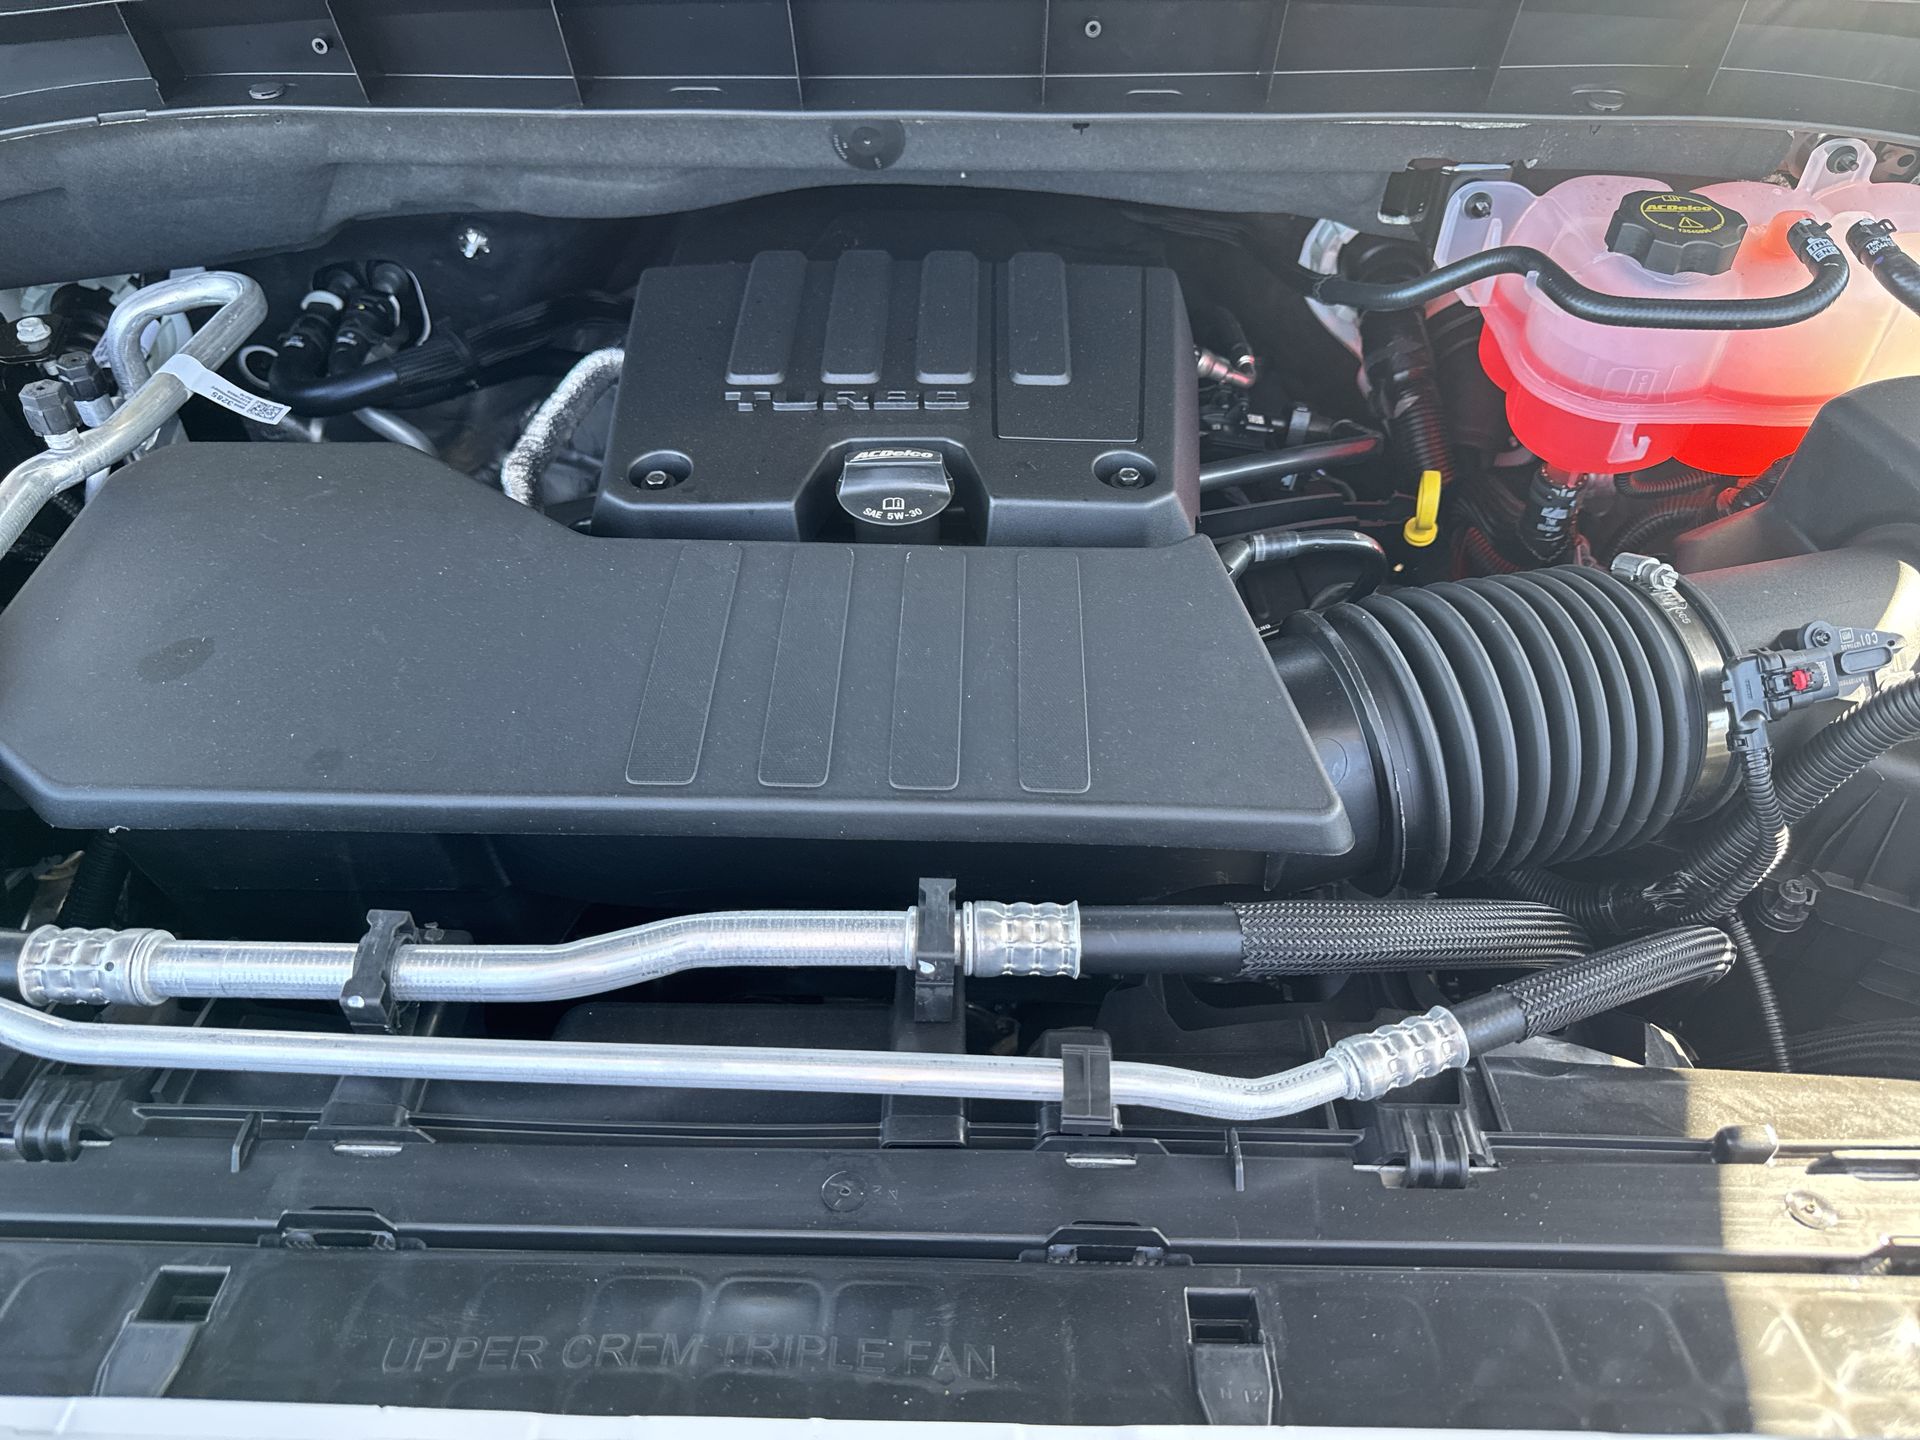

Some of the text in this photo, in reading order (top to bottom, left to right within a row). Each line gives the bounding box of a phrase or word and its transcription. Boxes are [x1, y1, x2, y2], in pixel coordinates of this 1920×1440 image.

[1644, 204, 1713, 213] ACDelco
[211, 391, 234, 407] 3285
[725, 391, 970, 412] TURBO
[851, 449, 934, 460] ACDelco
[863, 507, 923, 520] SAE 5W-30
[381, 1334, 549, 1375] UPPER
[717, 1332, 888, 1374] TRIPLE
[903, 1338, 996, 1380] FAN
